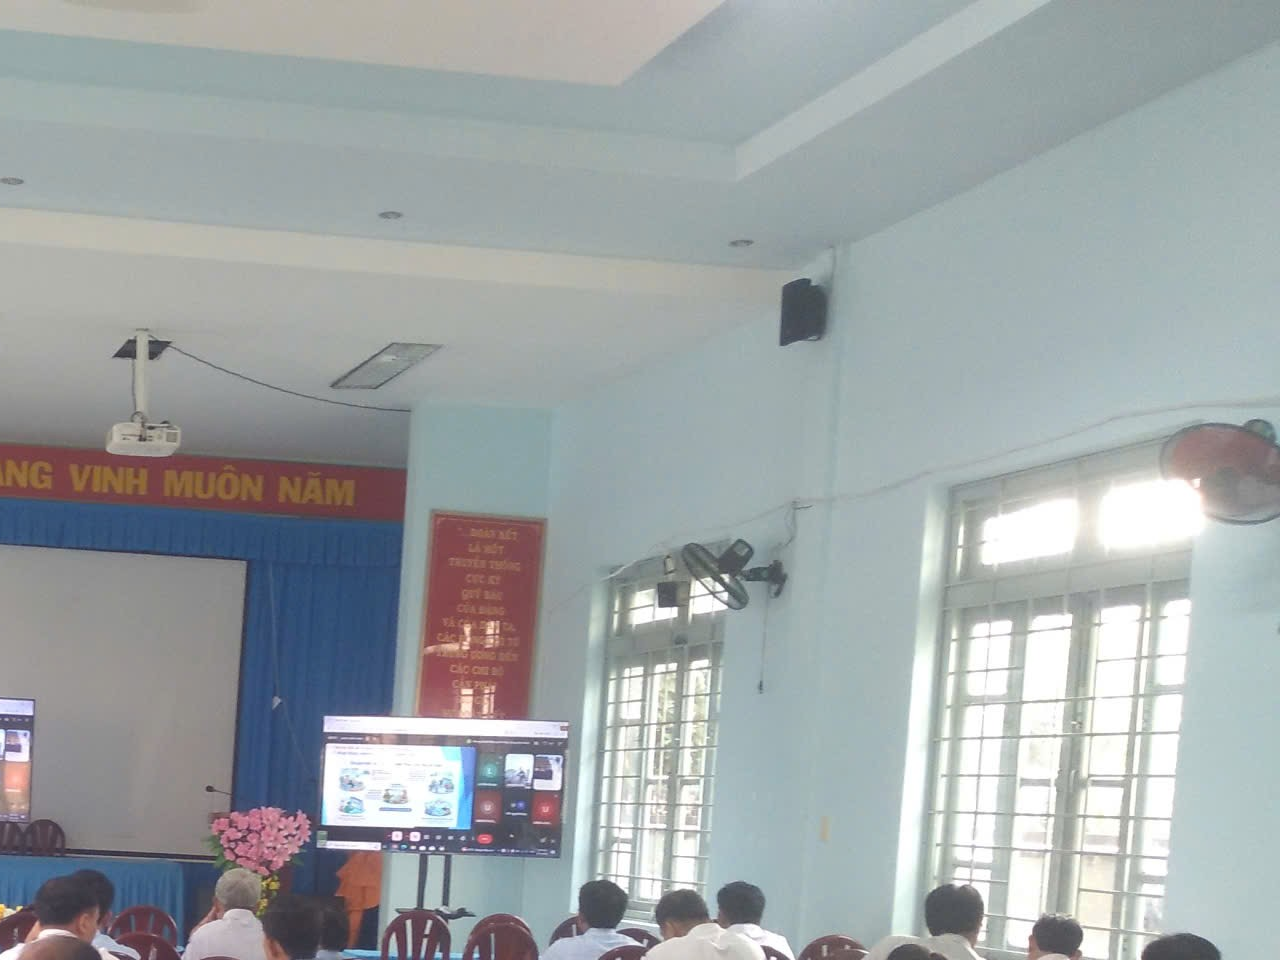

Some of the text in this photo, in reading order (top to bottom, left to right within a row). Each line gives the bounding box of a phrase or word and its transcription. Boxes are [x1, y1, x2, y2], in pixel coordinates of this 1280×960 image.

[70, 464, 148, 496] VINH
[163, 463, 262, 501] MUÔN
[278, 472, 356, 506] NĂM
